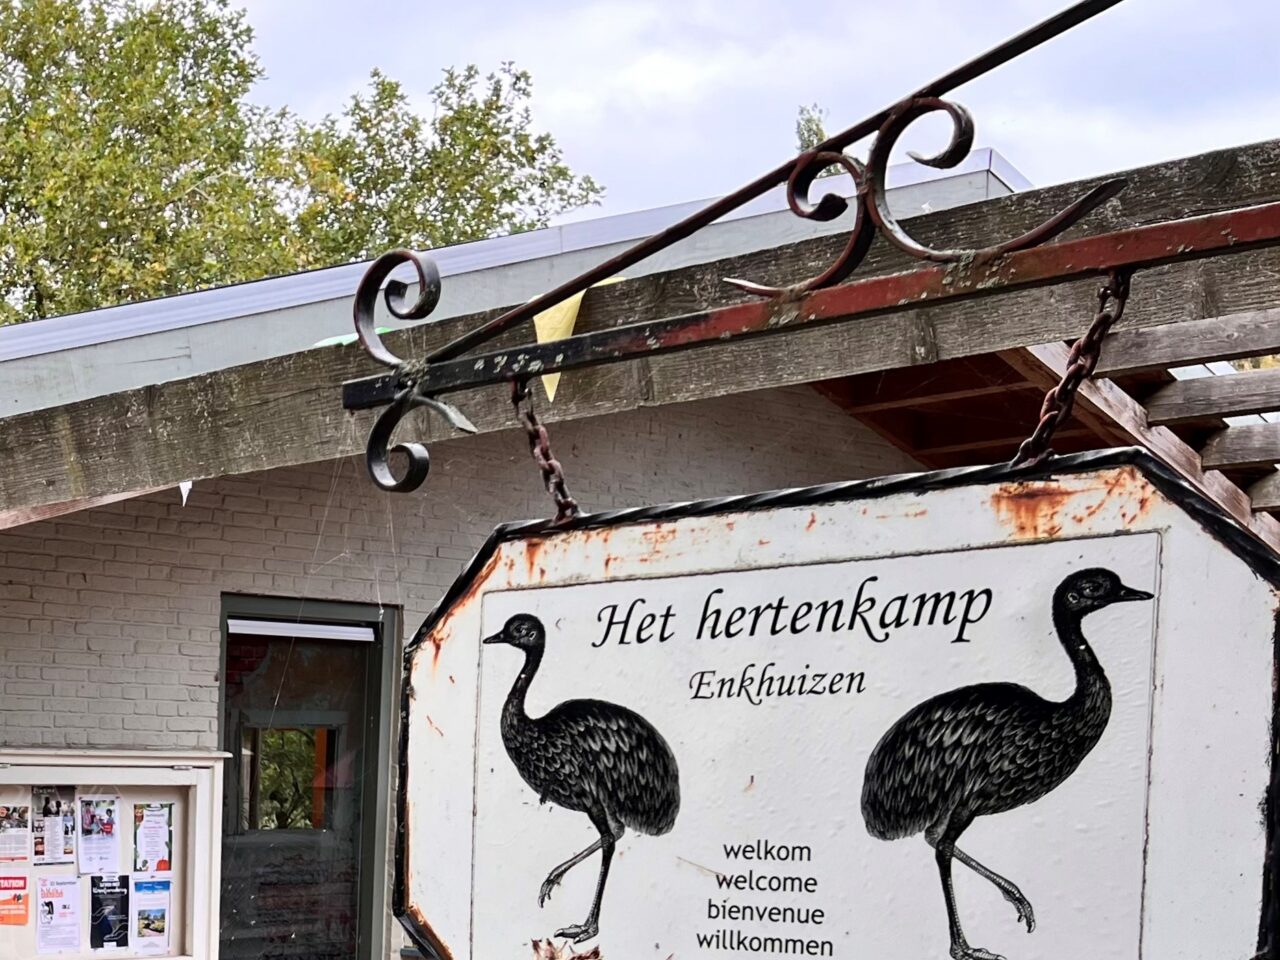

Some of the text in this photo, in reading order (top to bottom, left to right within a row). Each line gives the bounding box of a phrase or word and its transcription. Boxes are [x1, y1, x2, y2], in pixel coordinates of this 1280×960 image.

[591, 576, 993, 647] Het hertenkamp
[688, 662, 867, 706] Enkhuizen
[723, 839, 812, 862] welkom
[716, 869, 818, 893] welcome
[707, 898, 825, 925] bienvenue
[696, 929, 834, 957] willkommen
